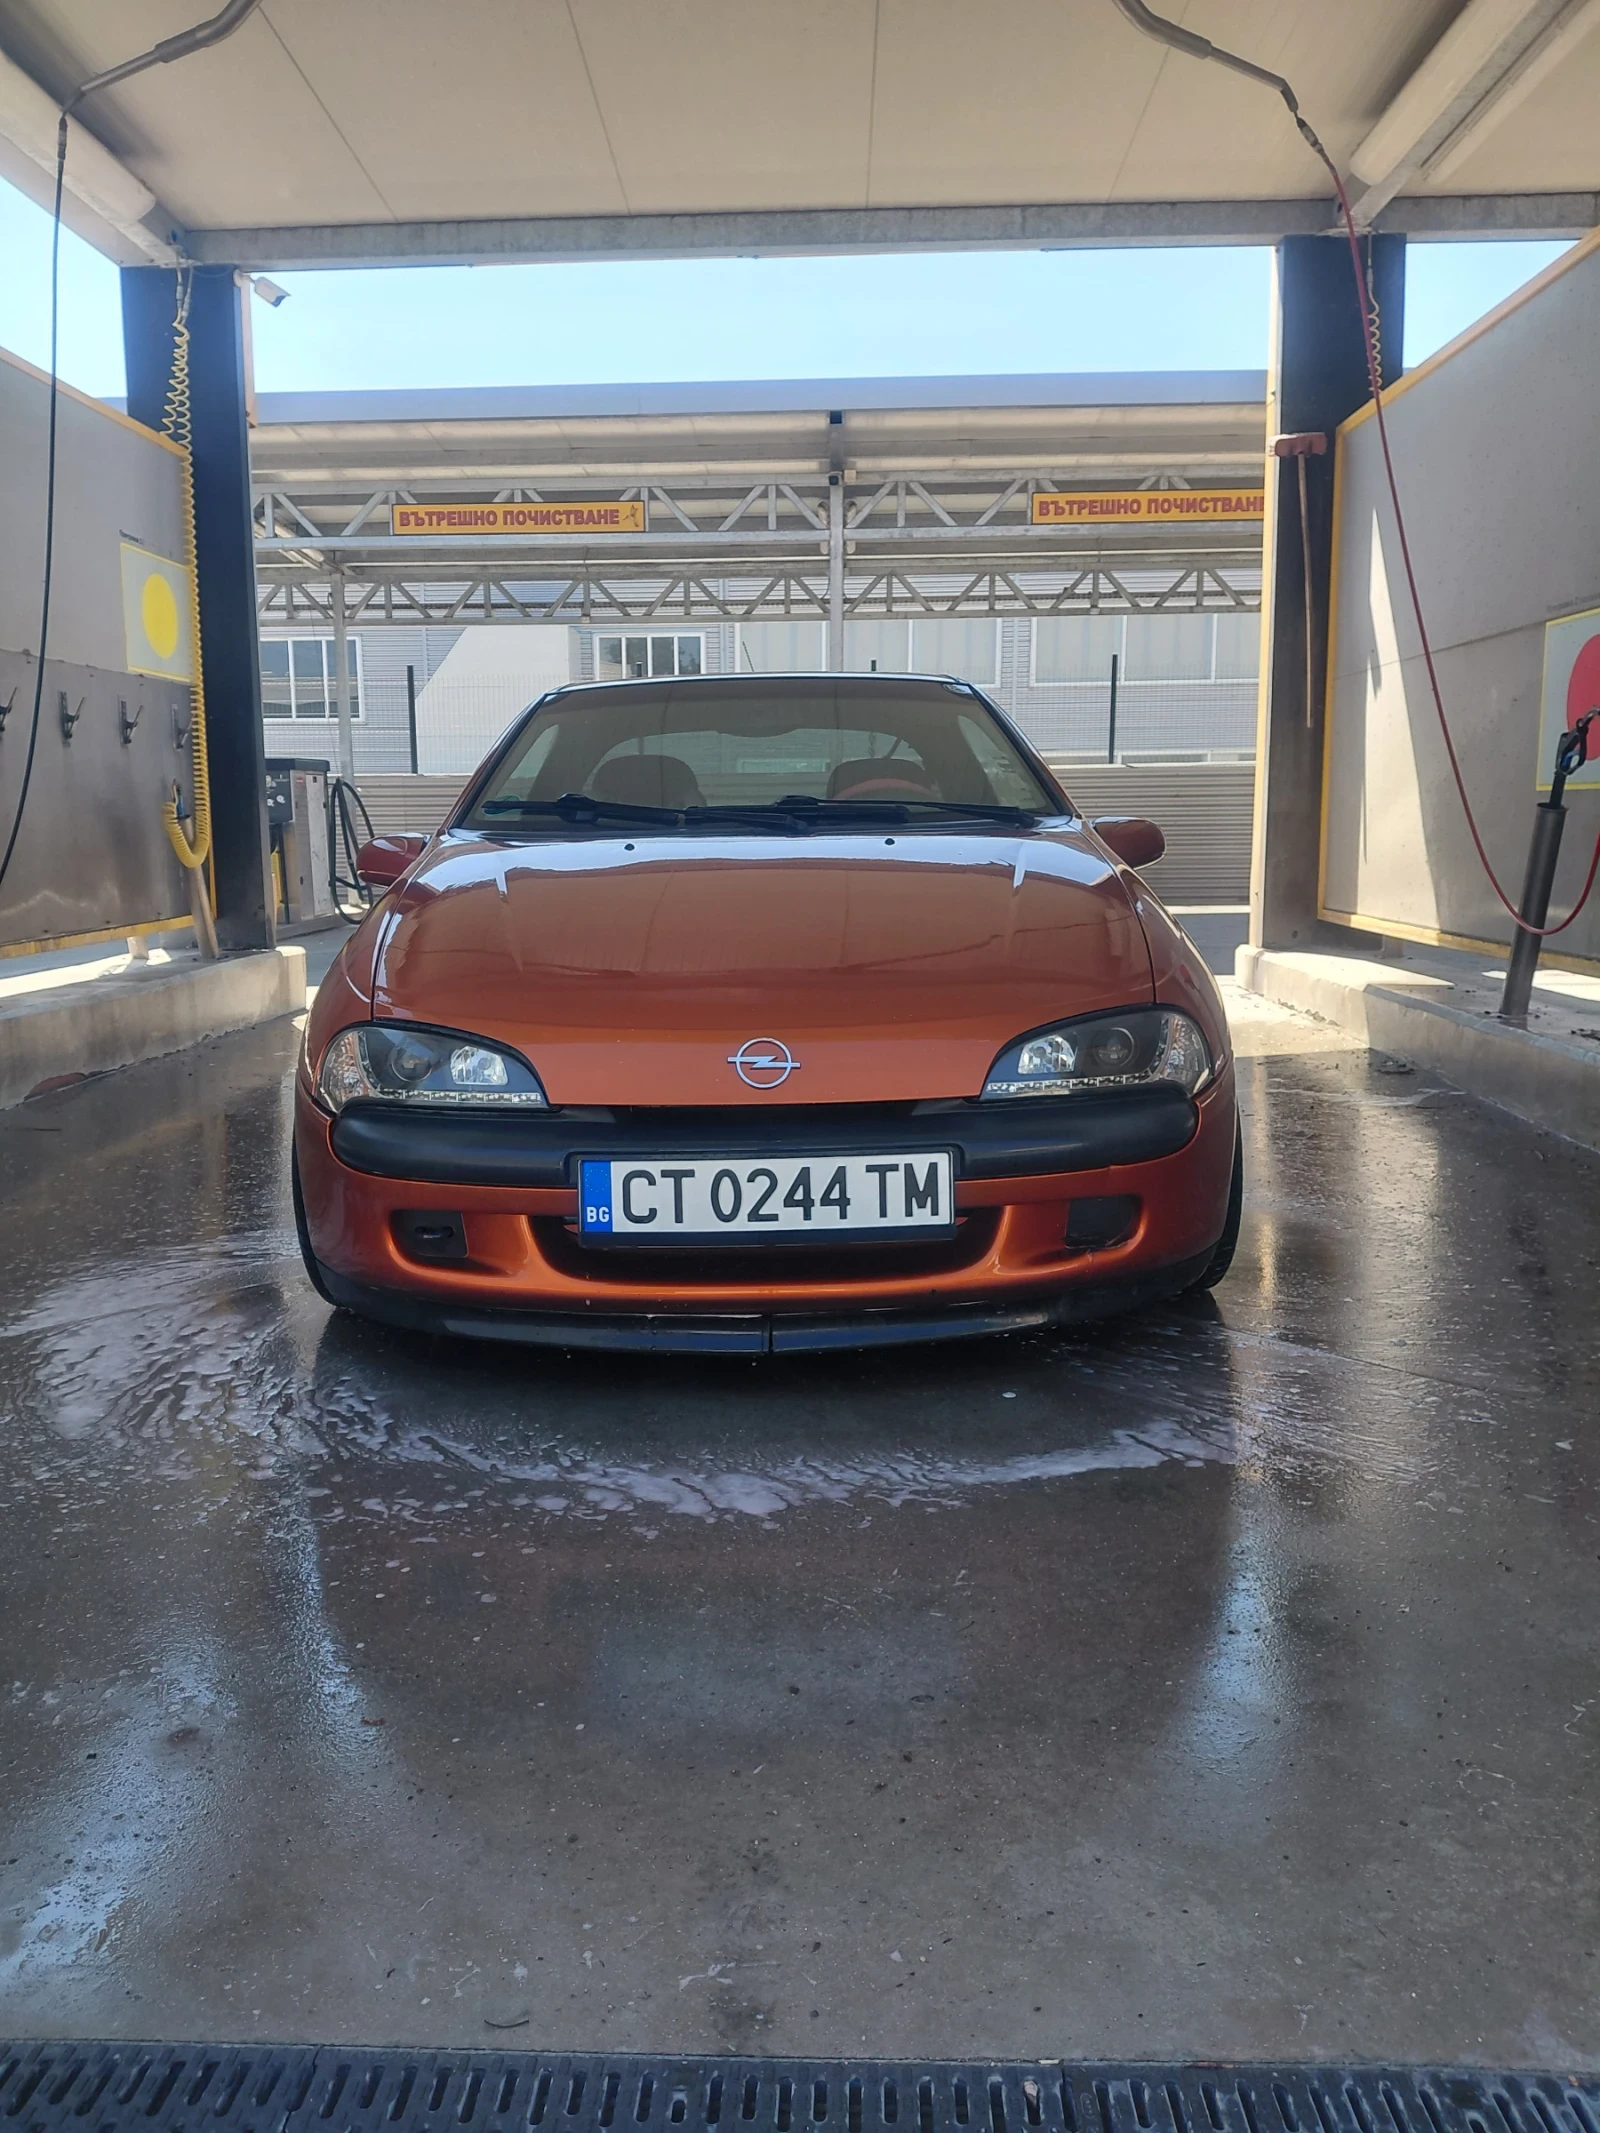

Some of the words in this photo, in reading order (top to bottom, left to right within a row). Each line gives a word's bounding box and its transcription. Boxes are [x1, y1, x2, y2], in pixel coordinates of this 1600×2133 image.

[1038, 499, 1142, 516] ВЪТРЕШНО
[399, 510, 498, 527] ВЪТРЕШНО
[503, 508, 620, 526] ПОЧИСТВАНЕ
[622, 1169, 695, 1224] CT
[710, 1165, 851, 1223] 0244
[865, 1161, 940, 1219] TM
[586, 1207, 610, 1224] BG
